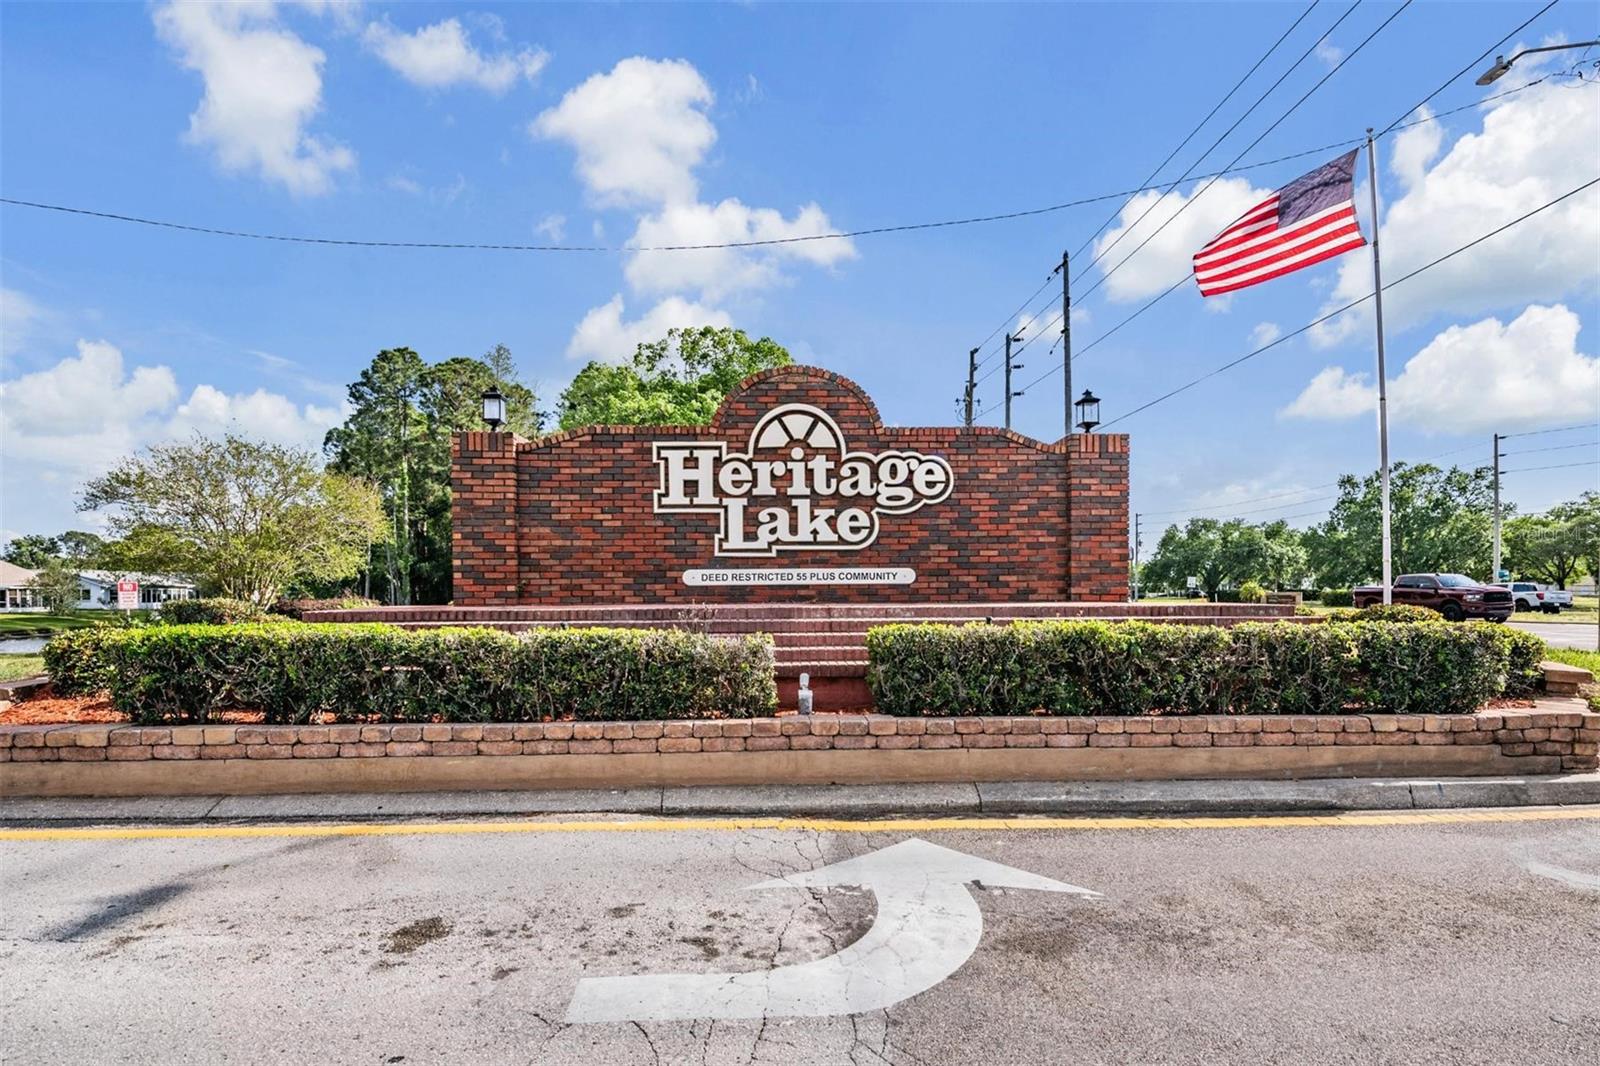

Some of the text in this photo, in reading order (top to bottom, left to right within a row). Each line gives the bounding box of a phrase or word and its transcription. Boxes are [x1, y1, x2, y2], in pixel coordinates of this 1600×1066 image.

[660, 447, 946, 506] Heritage
[722, 498, 870, 550] Lake
[701, 572, 898, 582] DEED RESTRICTED 55 PLUS COMMUNITY
